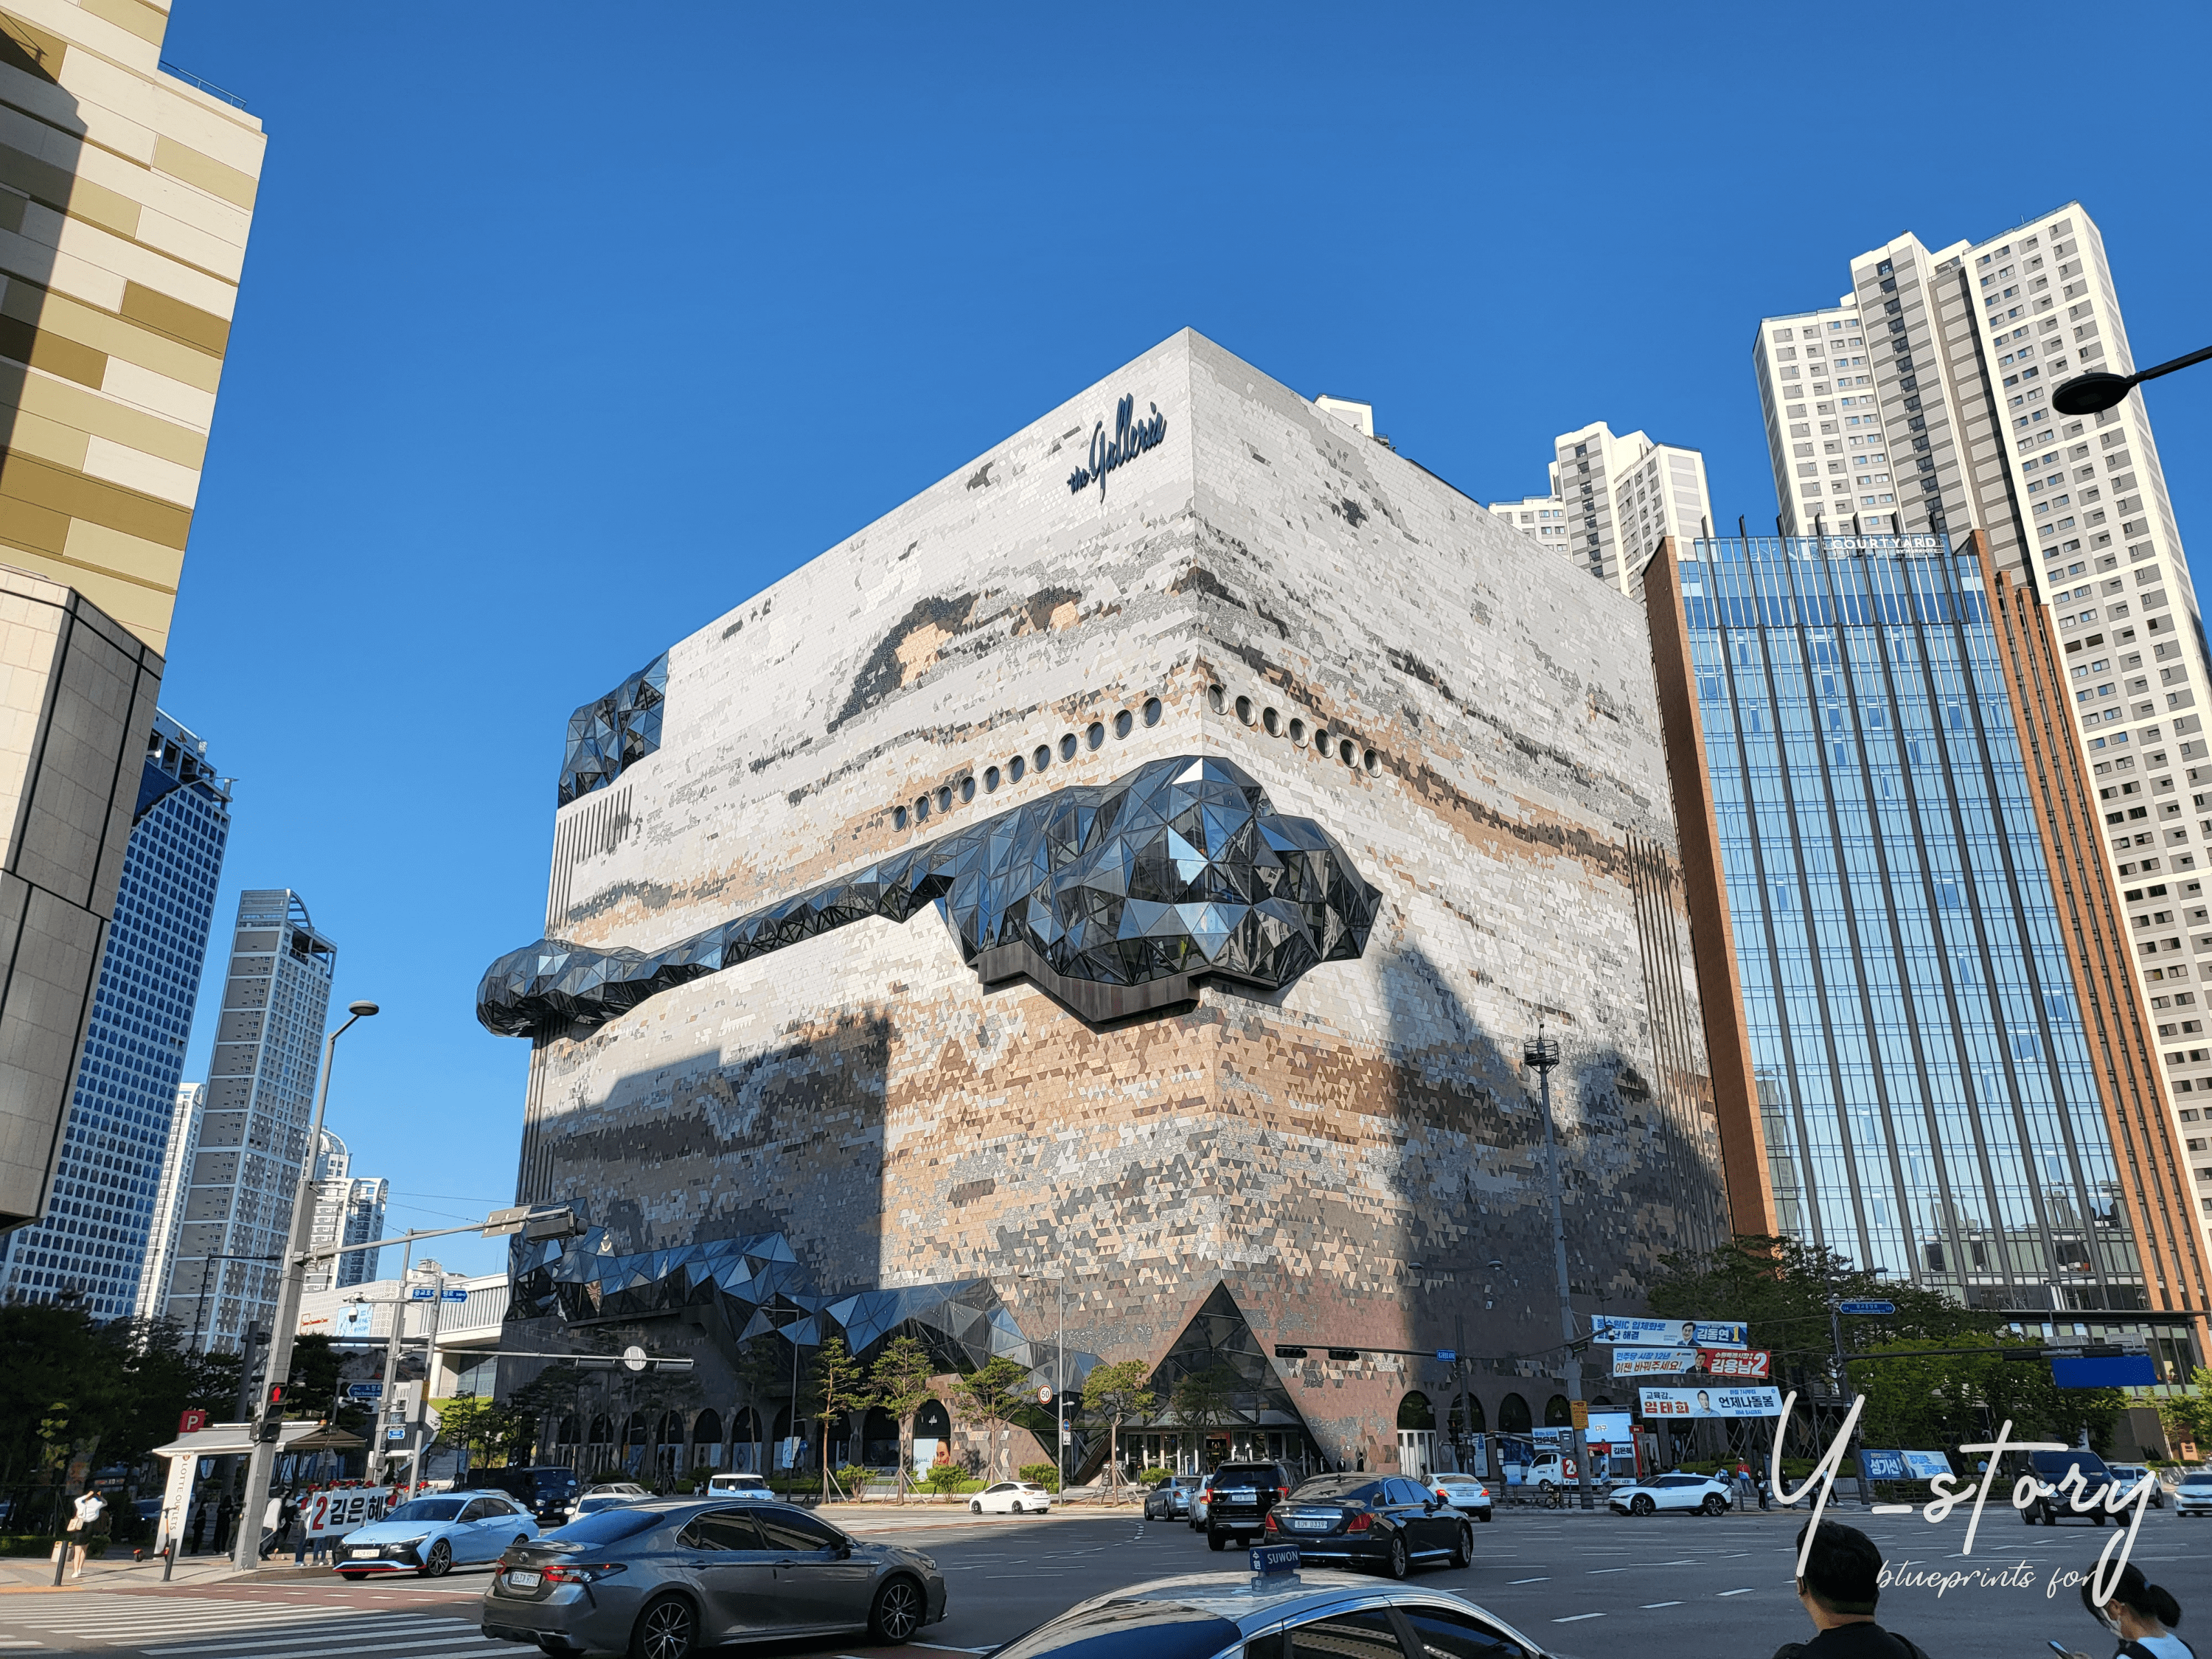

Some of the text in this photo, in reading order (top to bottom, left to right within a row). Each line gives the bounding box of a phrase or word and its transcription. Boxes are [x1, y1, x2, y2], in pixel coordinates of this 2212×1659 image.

[1067, 392, 1167, 506] the Galleria
[1832, 538, 1936, 549] COURTYARD
[1632, 1321, 1666, 1332] 입체화로
[1623, 1330, 1640, 1340] 해결
[1697, 1326, 1740, 1342] 김동연 1
[1616, 1352, 1638, 1361] 민주당
[1638, 1352, 1653, 1360] 시장
[1655, 1352, 1671, 1360] 12년
[1615, 1360, 1683, 1373] 이젠 바꿔주세요!
[1711, 1352, 1767, 1376] 김용남 2
[1041, 1390, 1050, 1399] 50
[1646, 1391, 1669, 1399] 교육감
[1644, 1401, 1690, 1414] 임태희
[1718, 1395, 1775, 1408] 언제나돌봄
[187, 1415, 199, 1430] P
[1613, 1447, 1632, 1455] 김은혜
[1565, 1458, 1576, 1475] 2
[170, 1462, 187, 1531] LOTTE OUTLETS
[312, 1495, 384, 1531] 2 김은혜
[1252, 1551, 1262, 1570] 수원
[1267, 1550, 1299, 1565] SUWON
